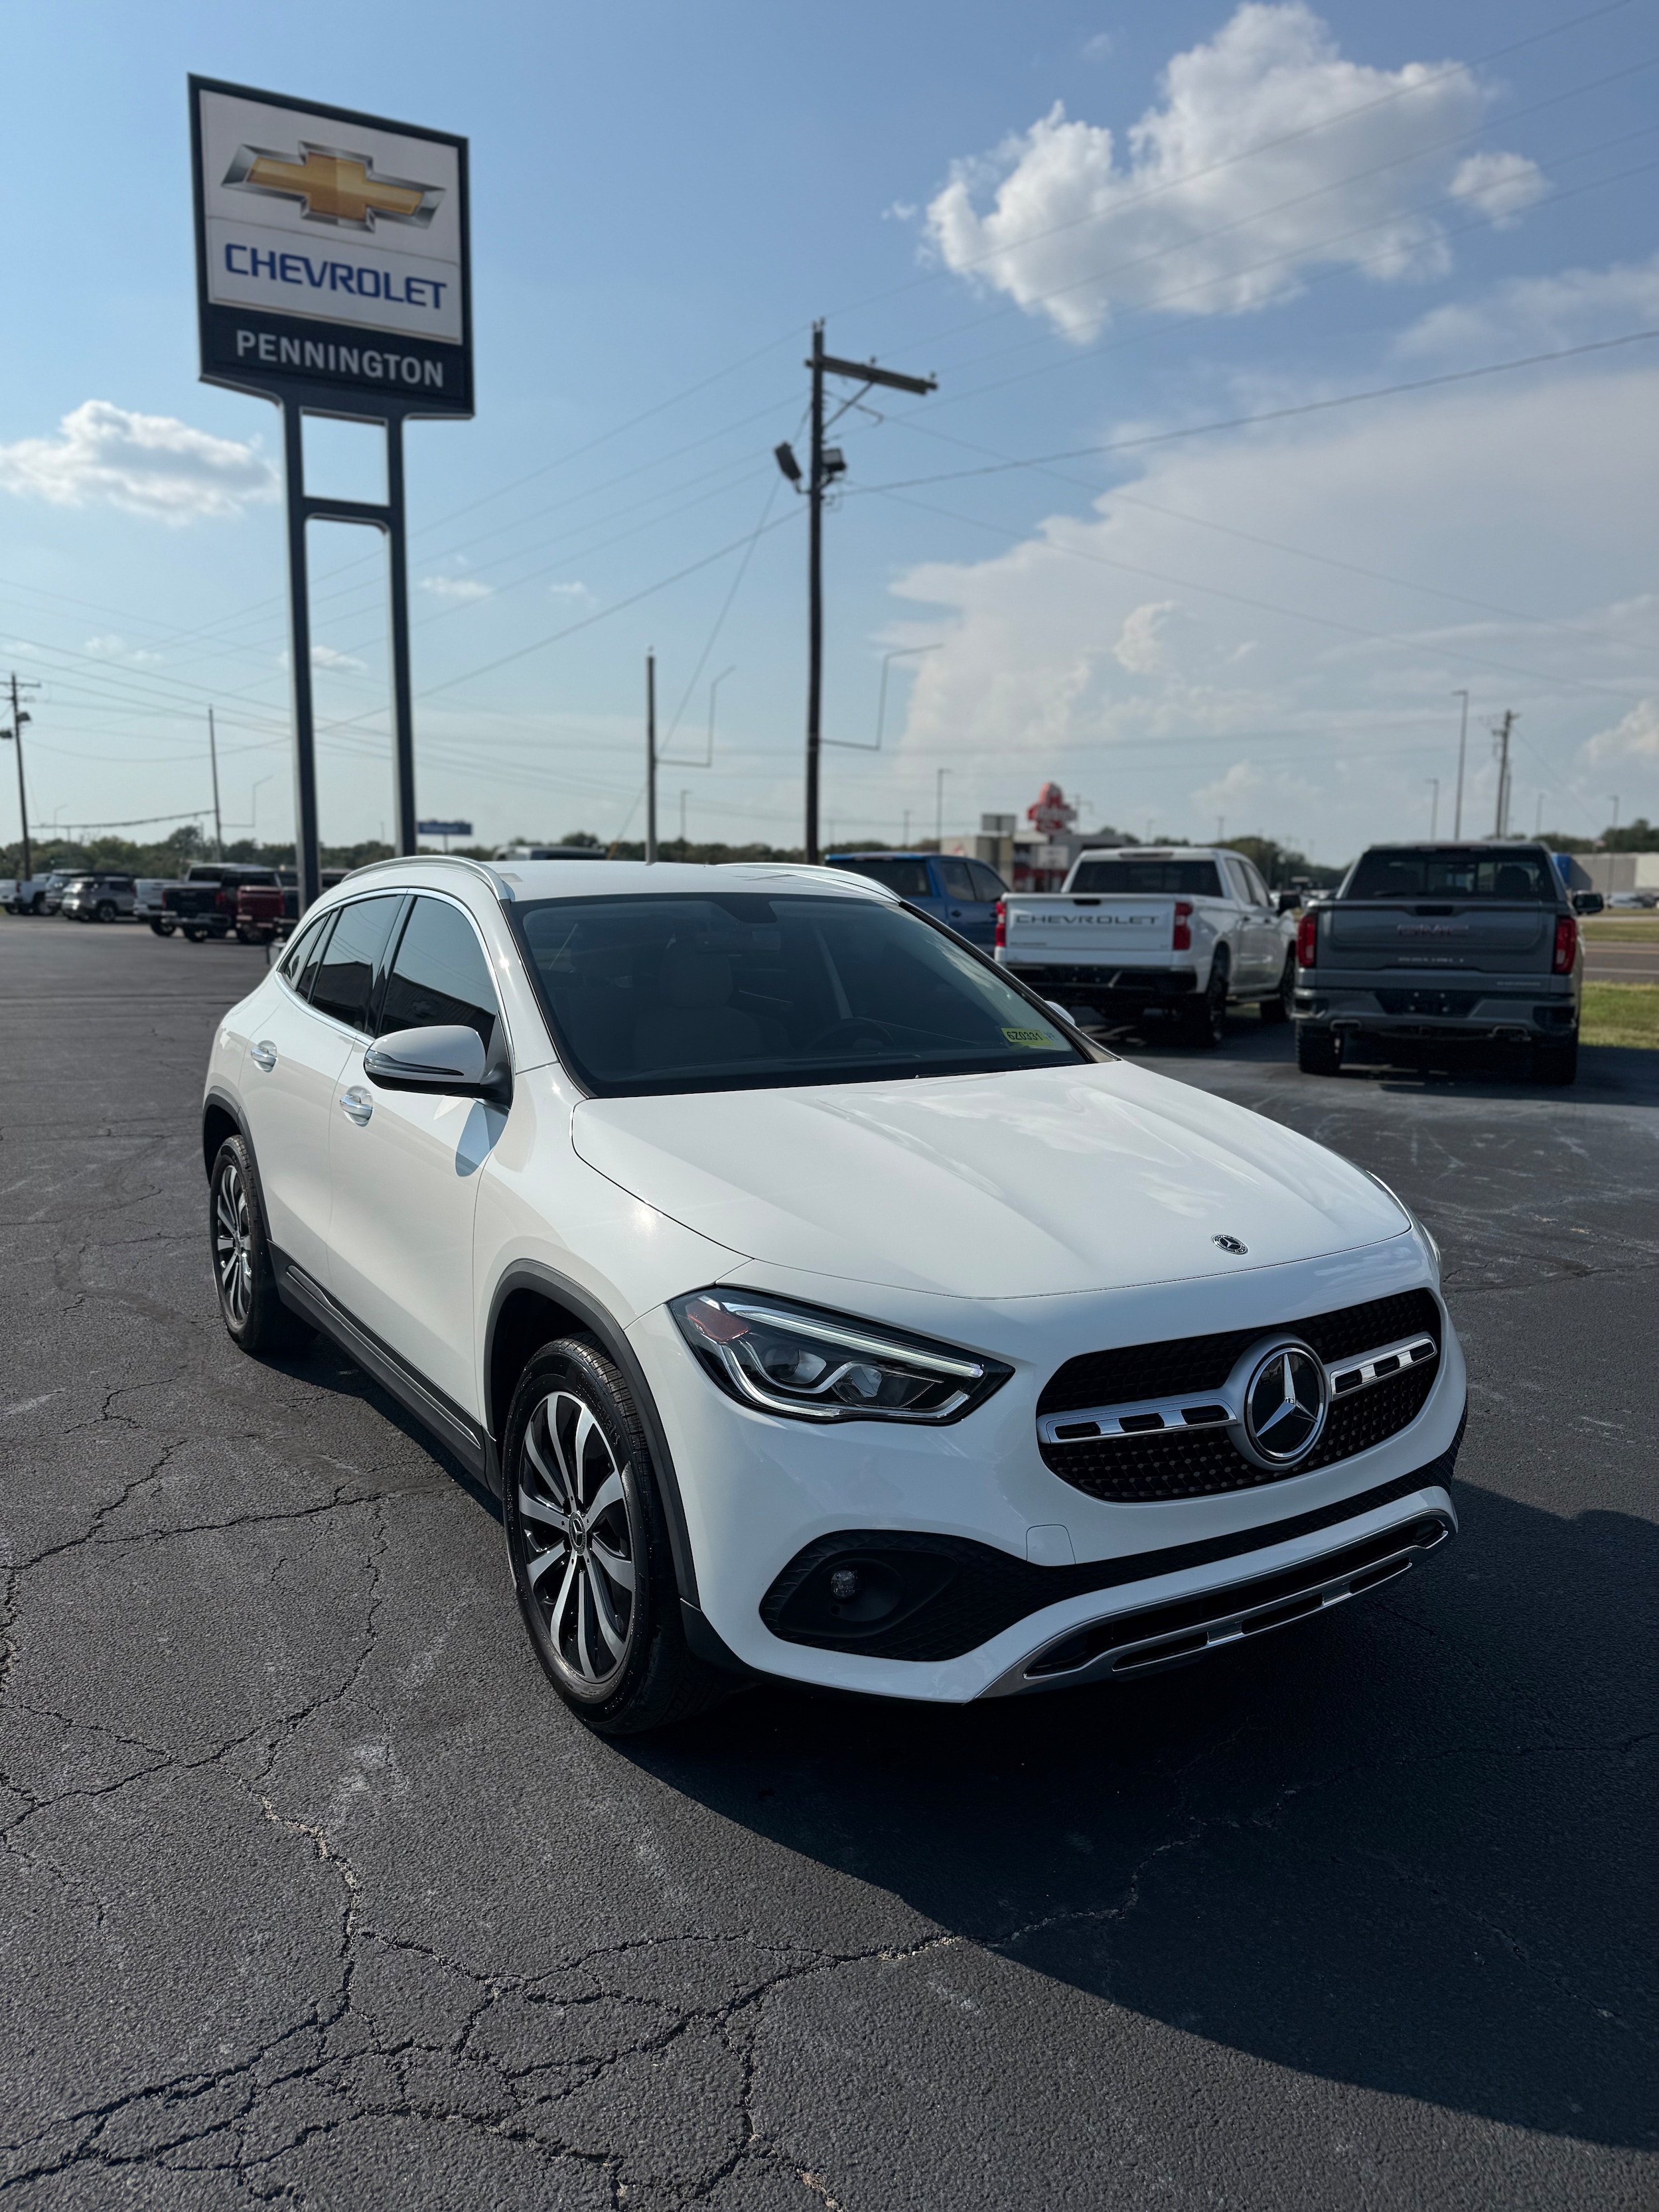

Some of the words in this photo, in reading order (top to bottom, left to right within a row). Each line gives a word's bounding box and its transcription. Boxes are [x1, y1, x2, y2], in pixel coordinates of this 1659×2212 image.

[225, 243, 448, 309] CHEVROLET
[236, 329, 444, 388] PENNINGTON
[1016, 915, 1159, 924] CHEVROLET
[1007, 1031, 1043, 1041] 6Z0331
